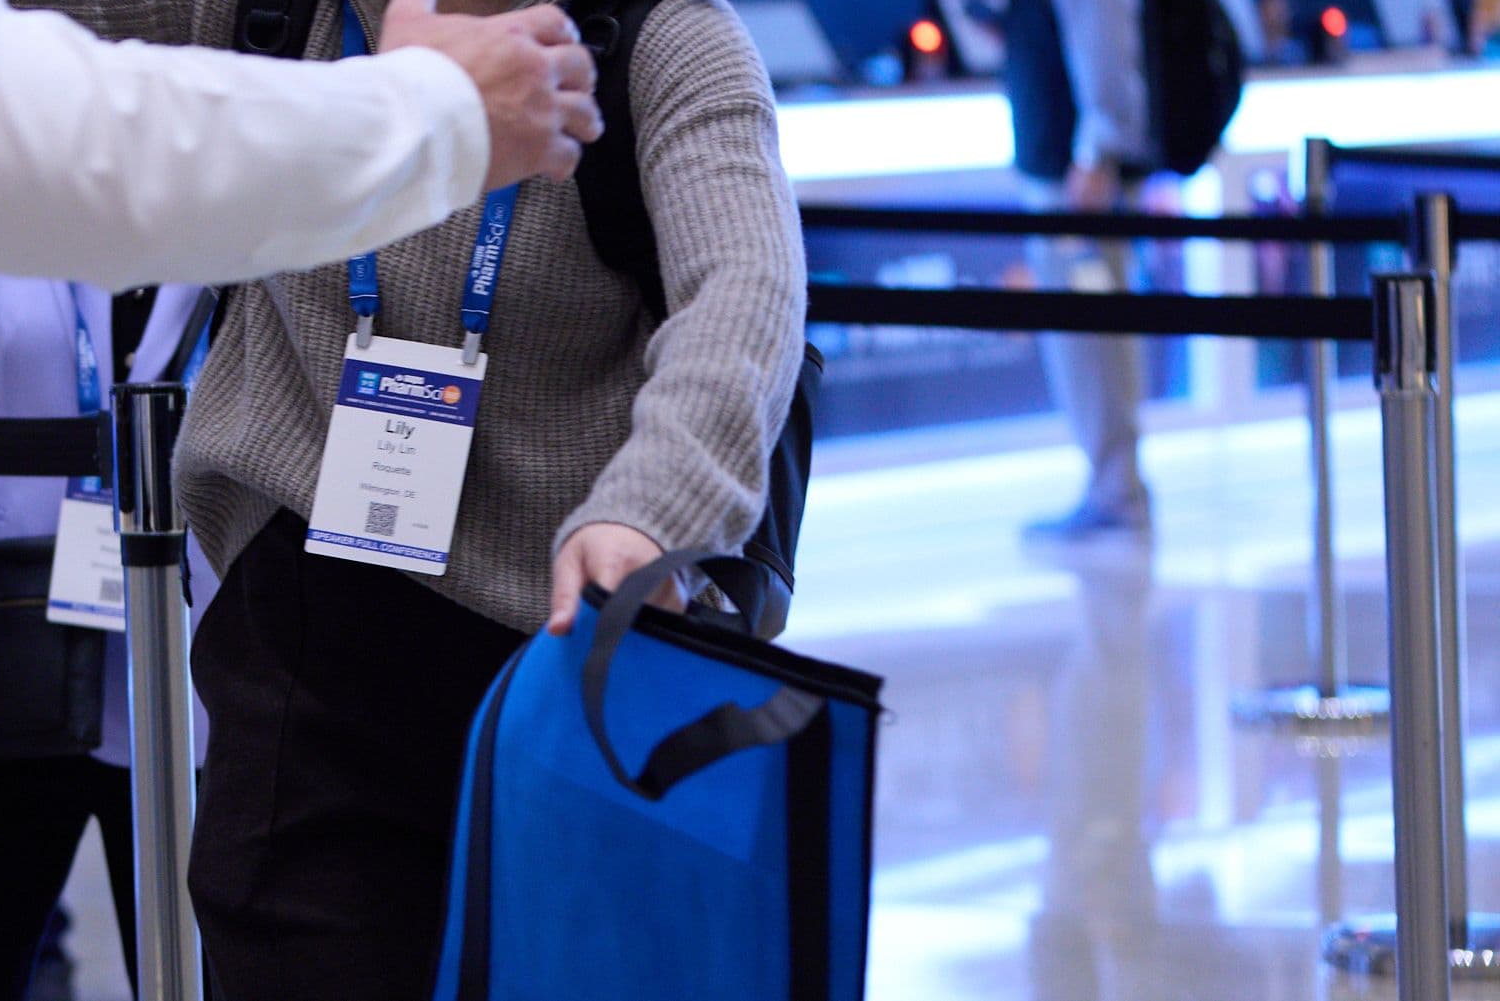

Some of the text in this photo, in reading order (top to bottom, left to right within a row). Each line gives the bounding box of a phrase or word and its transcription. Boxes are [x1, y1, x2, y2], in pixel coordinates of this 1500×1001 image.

[472, 222, 506, 296] PharmSci
[385, 419, 415, 440] Lily
[312, 531, 355, 546] SPEAKER
[380, 541, 443, 561] CONFERENCE
